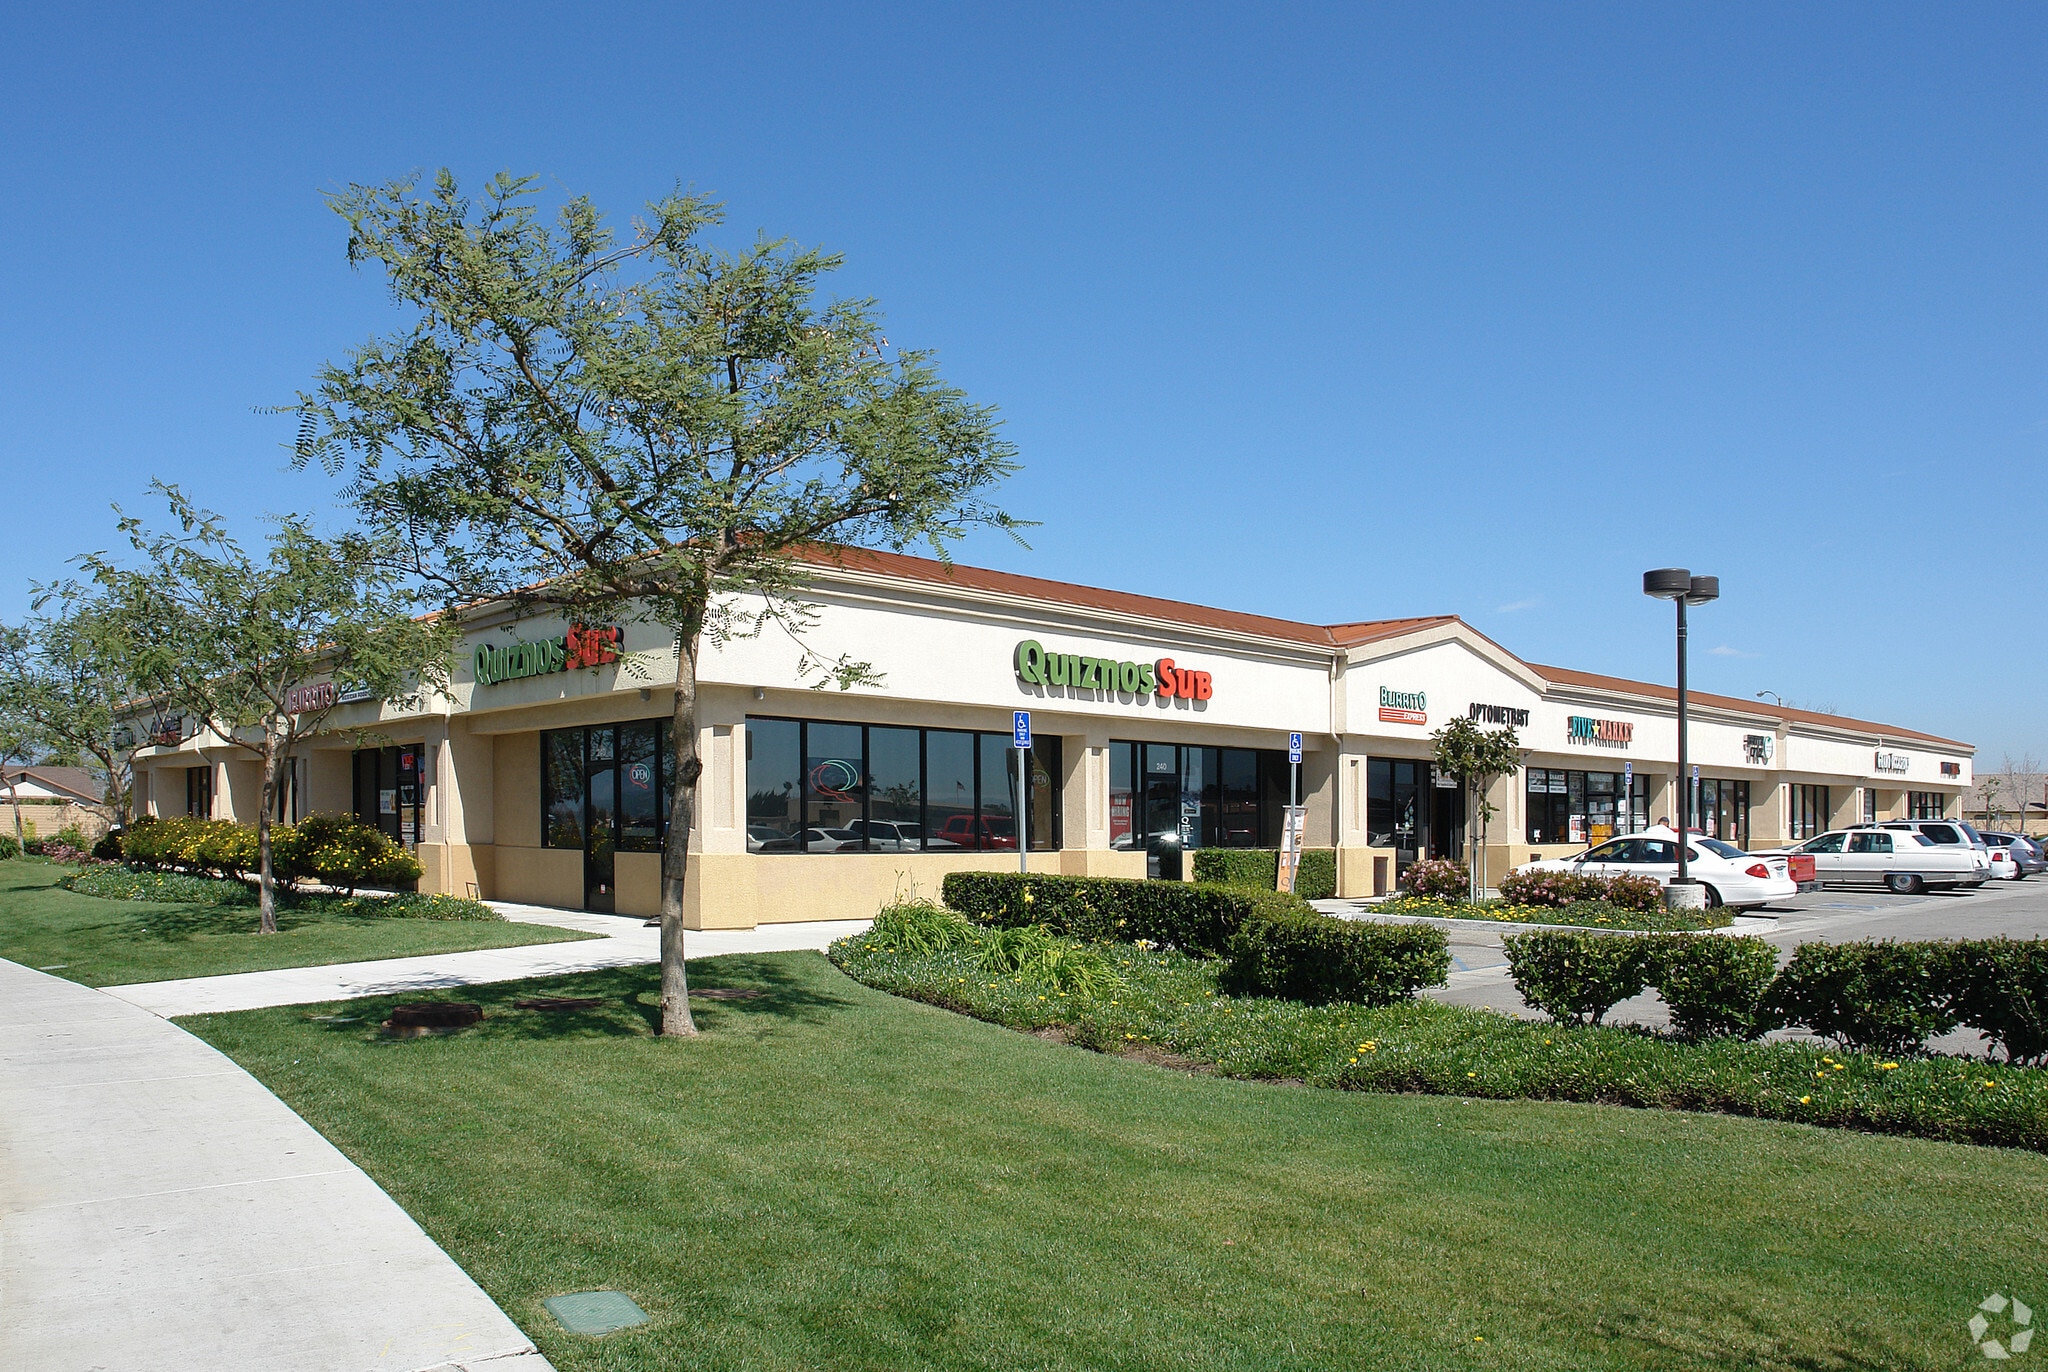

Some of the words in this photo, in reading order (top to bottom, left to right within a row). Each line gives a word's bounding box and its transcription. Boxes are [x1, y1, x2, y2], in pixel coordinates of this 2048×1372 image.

[1380, 686, 1427, 711] BURRITO
[1404, 712, 1425, 722] EXPRESS
[1469, 702, 1530, 727] OPTOMETRIST
[1567, 716, 1592, 738] FIVE
[1600, 719, 1633, 742] MARKET
[631, 768, 648, 780] OPEN
[1156, 762, 1167, 771] 240
